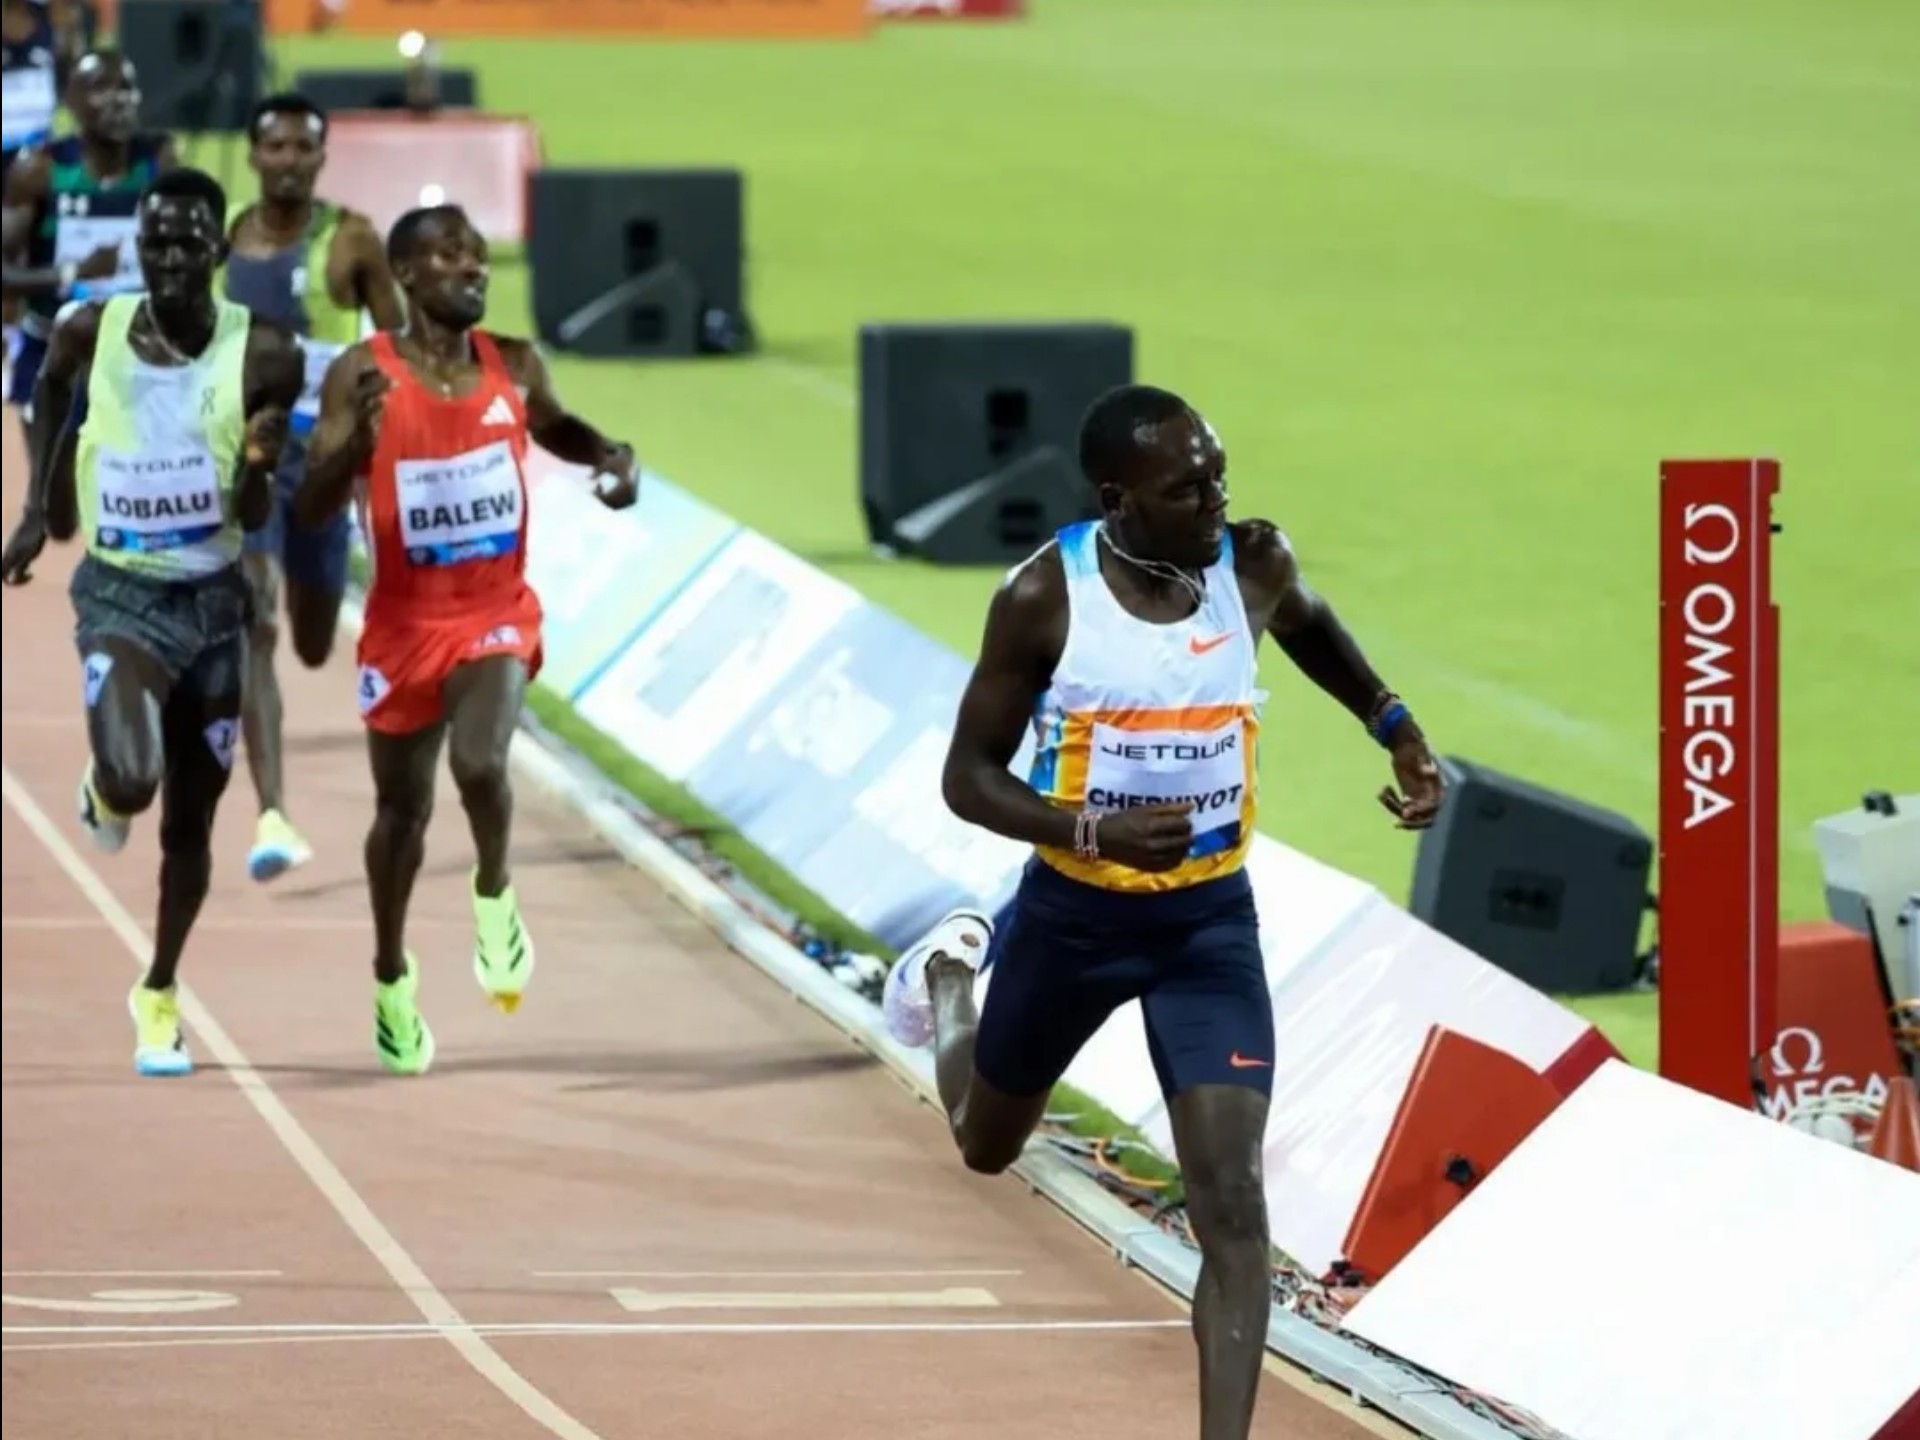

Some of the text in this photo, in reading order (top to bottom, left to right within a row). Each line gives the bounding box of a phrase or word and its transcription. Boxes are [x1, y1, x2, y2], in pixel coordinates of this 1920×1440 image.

[101, 490, 212, 520] LOBALU
[408, 489, 515, 531] BALEW
[1683, 583, 1736, 830] OMEGA
[1101, 733, 1236, 760] JETOUR
